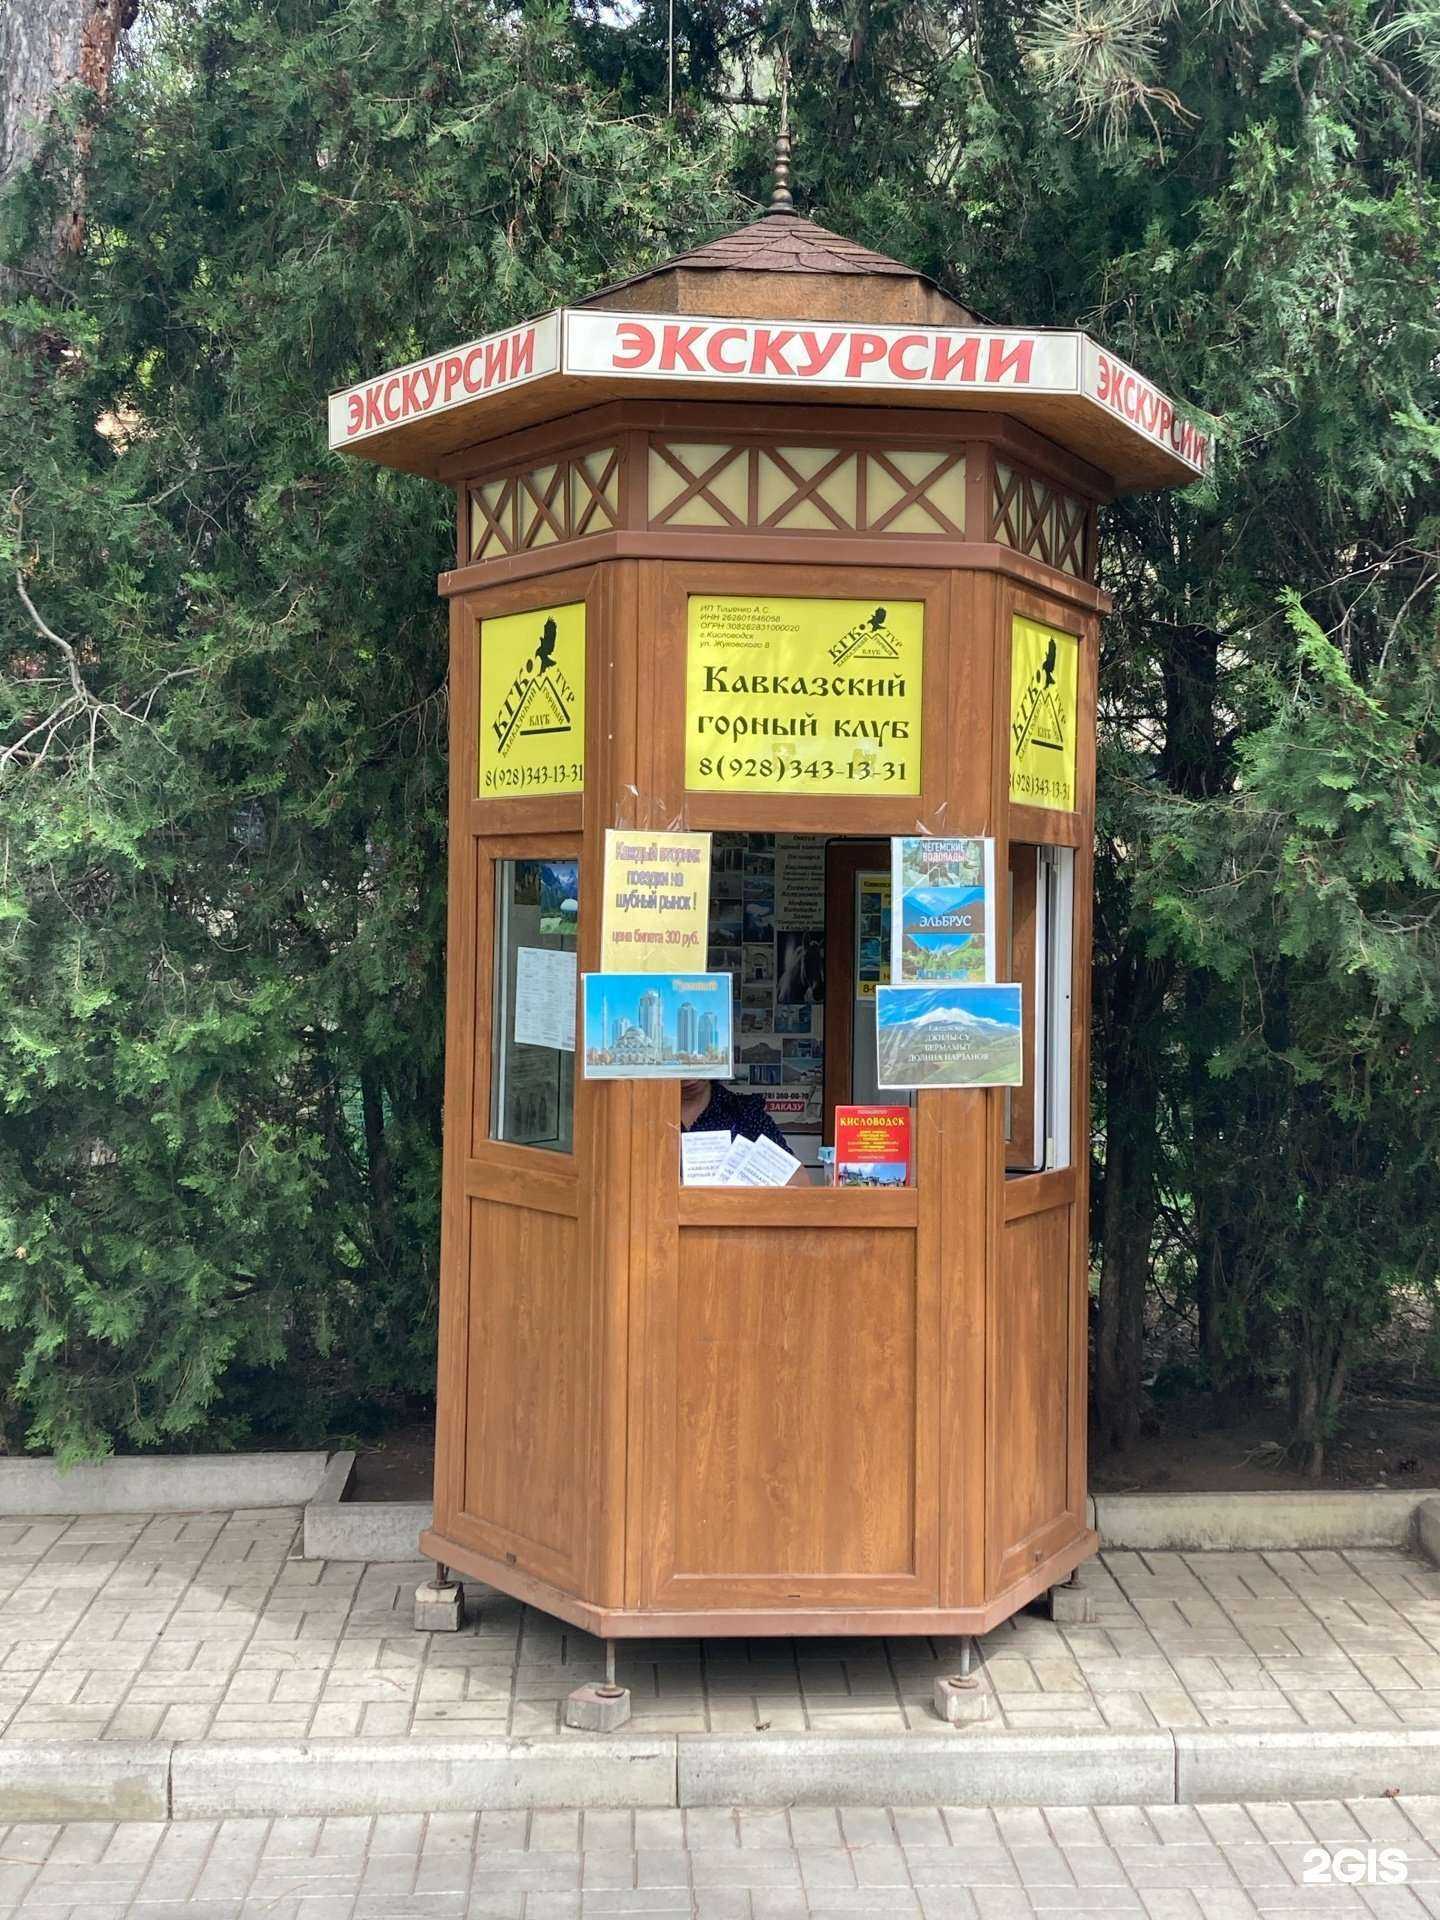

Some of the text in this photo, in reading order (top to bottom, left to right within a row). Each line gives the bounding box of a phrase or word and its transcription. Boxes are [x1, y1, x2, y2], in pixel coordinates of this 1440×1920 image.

[612, 322, 1035, 385] ЭКСКУРСИИ
[346, 328, 536, 437] ЭКСКУРСИИ
[556, 668, 576, 703] ТУР
[703, 665, 906, 697] Кавказский
[698, 711, 909, 747] горный клуб
[485, 763, 583, 790] 8(928)343-13-31
[699, 755, 906, 782] 8(928)343-13-31
[922, 841, 965, 852] ЧЕГЕМСКИЕ
[922, 851, 967, 862] ВОДОПАДЫ
[670, 871, 684, 887] на
[615, 889, 657, 913] шубный
[659, 895, 691, 914] рынок
[919, 914, 972, 927] ЭЛЬБРУС
[665, 930, 681, 944] 300
[769, 1102, 804, 1111] ЗАКАЗУ
[840, 1116, 905, 1127] КИСЛОВОДСК
